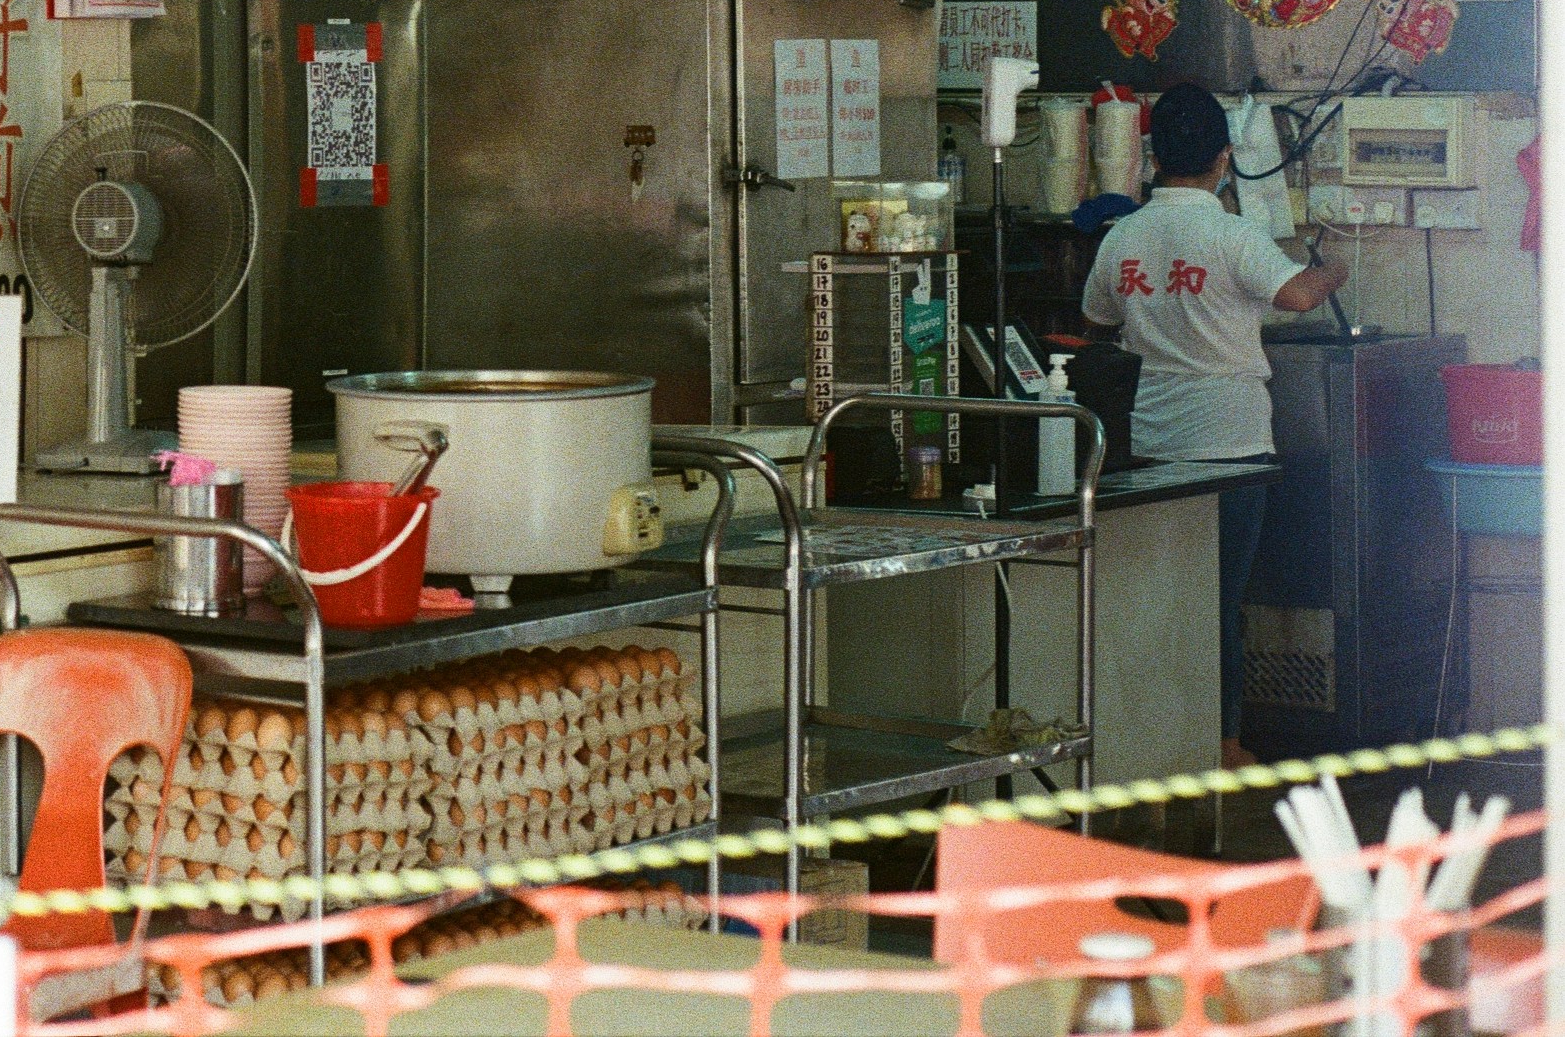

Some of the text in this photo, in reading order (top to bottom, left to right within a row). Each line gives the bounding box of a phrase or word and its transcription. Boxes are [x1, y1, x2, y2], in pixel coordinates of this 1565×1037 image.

[817, 258, 827, 271] 16
[817, 276, 828, 289] 17
[1116, 258, 1207, 297] 永和
[814, 294, 828, 307] 18
[816, 311, 827, 325] 19
[815, 330, 829, 342] 20
[815, 347, 827, 360] 21
[815, 366, 830, 378] 22
[815, 383, 830, 396] 23
